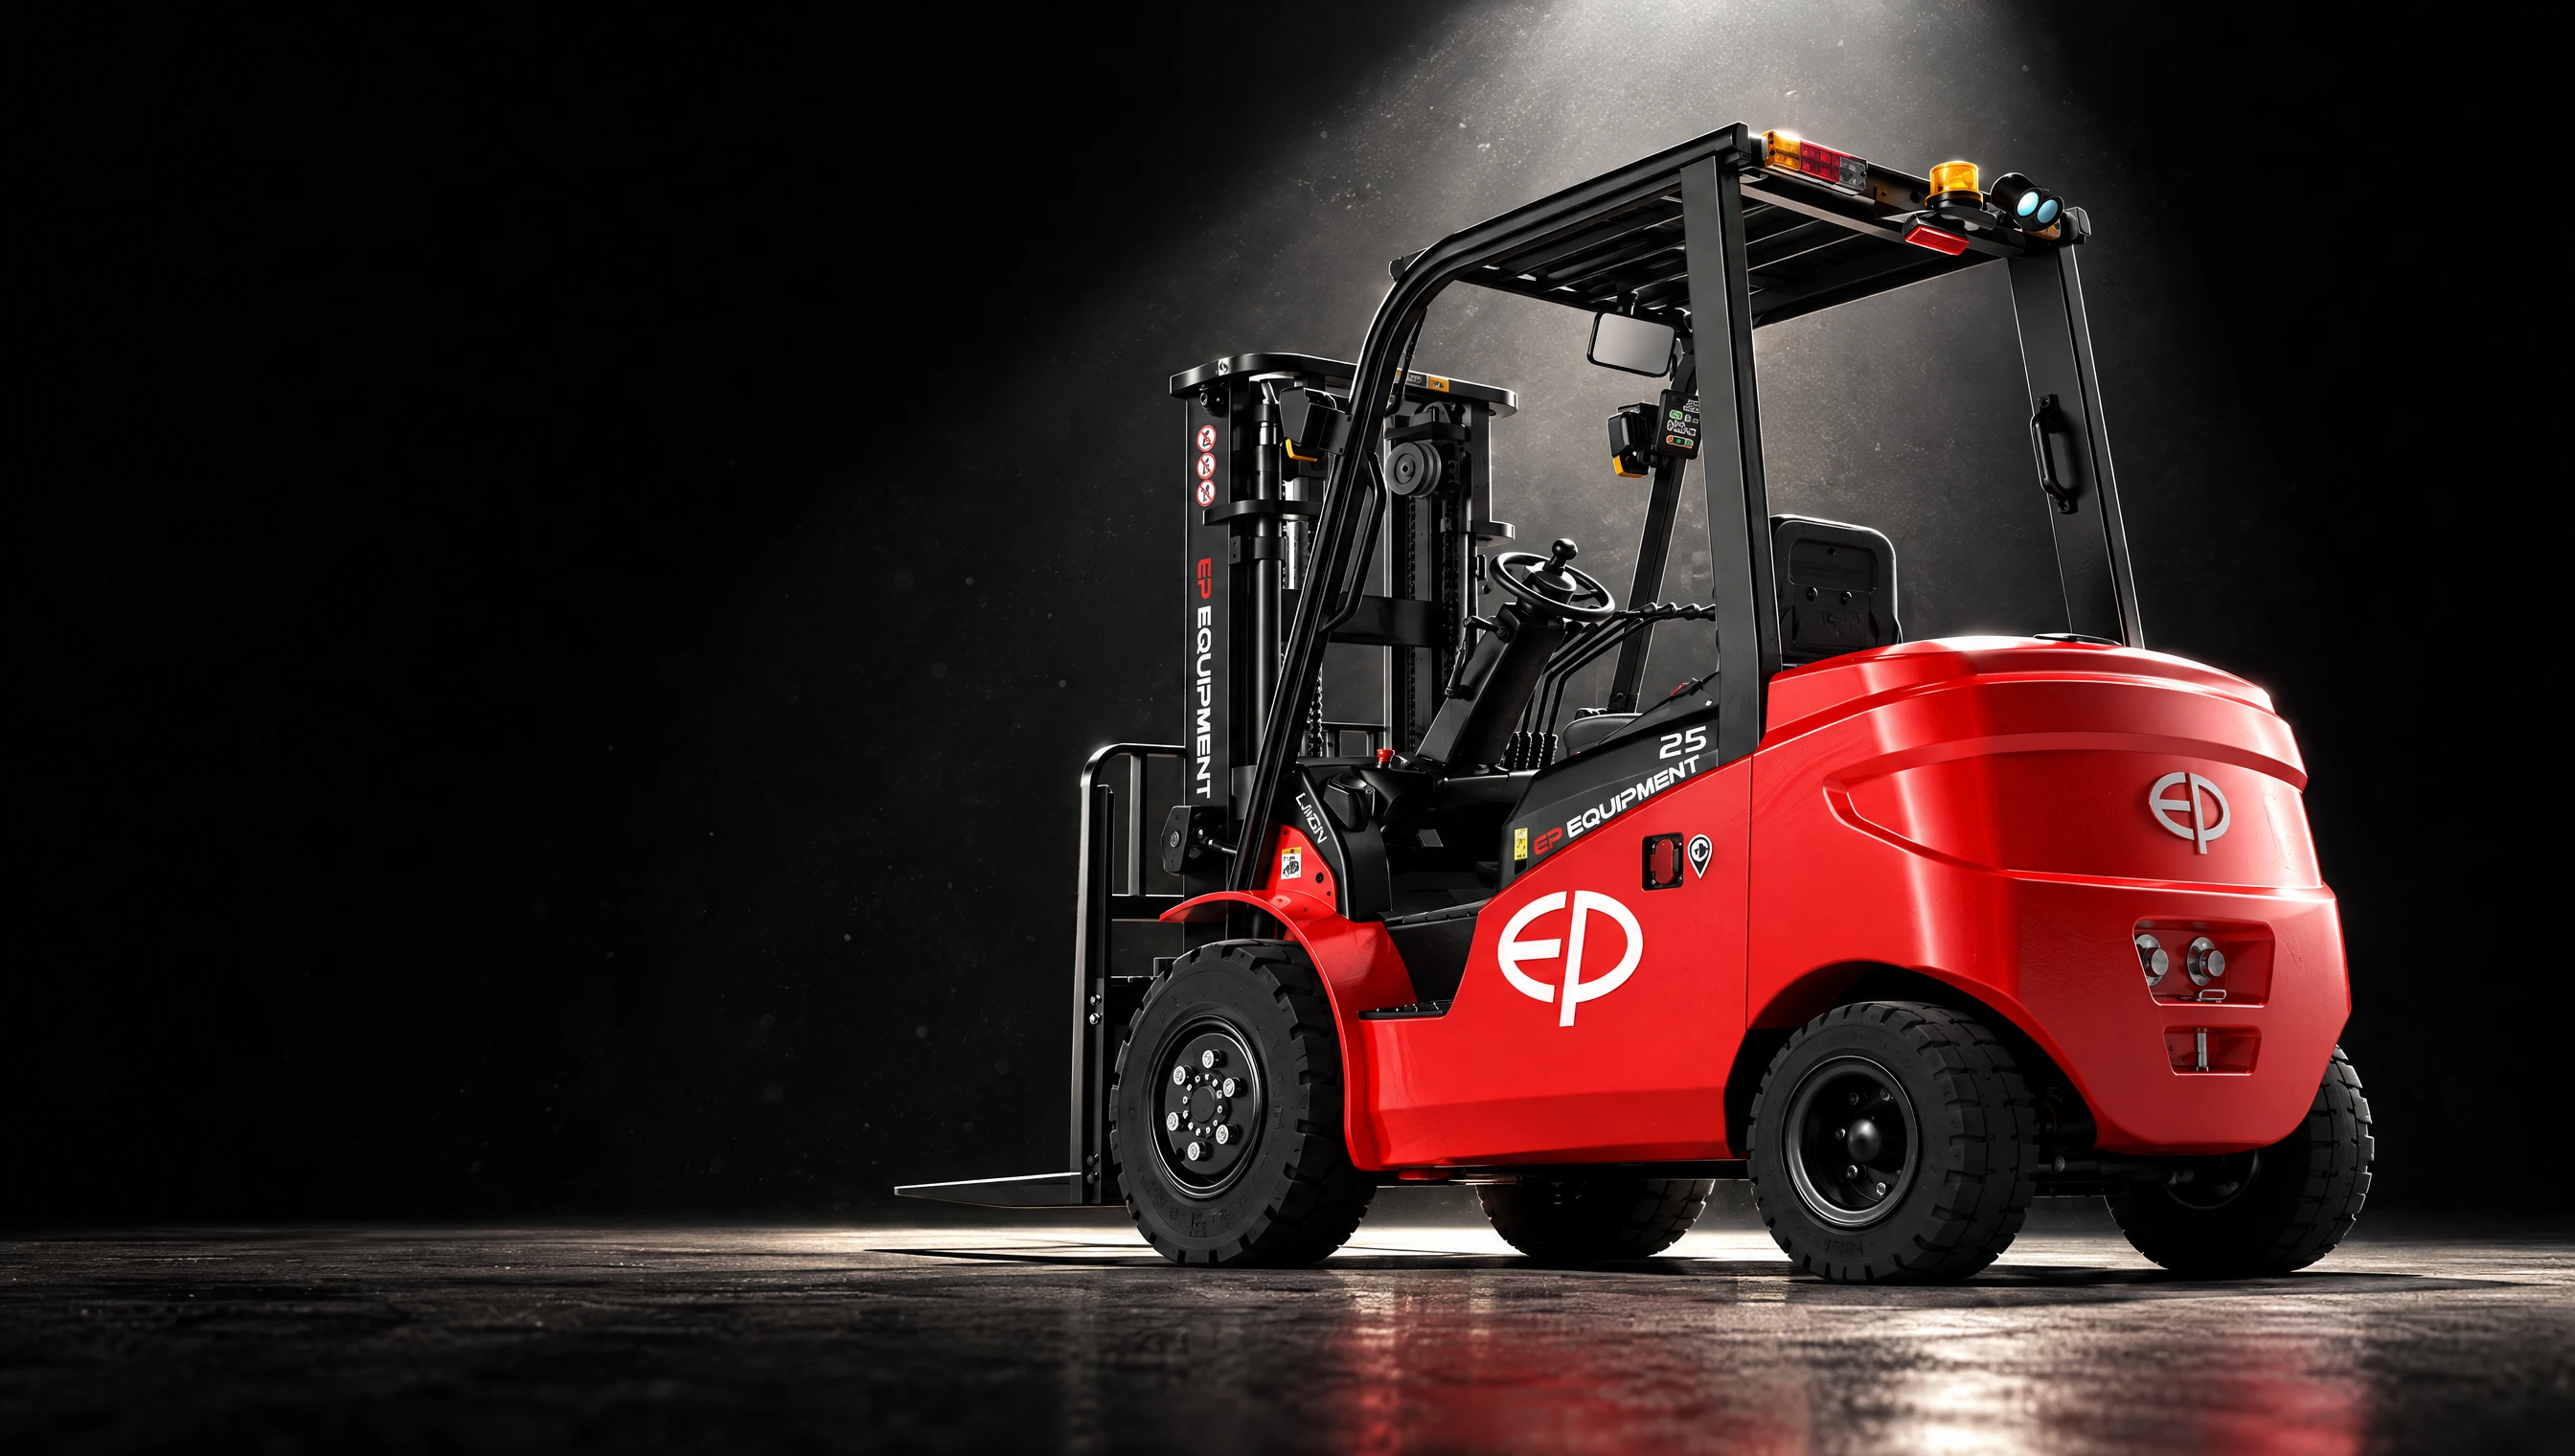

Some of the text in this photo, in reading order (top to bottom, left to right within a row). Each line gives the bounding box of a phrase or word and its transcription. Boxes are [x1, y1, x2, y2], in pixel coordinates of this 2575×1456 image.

[1196, 557, 1213, 800] EP EQUIPMENT
[1658, 725, 1708, 761] 25
[1533, 754, 1700, 855] EP EQUIPMENT
[2148, 771, 2231, 855] EP
[1497, 890, 1644, 1028] EP
